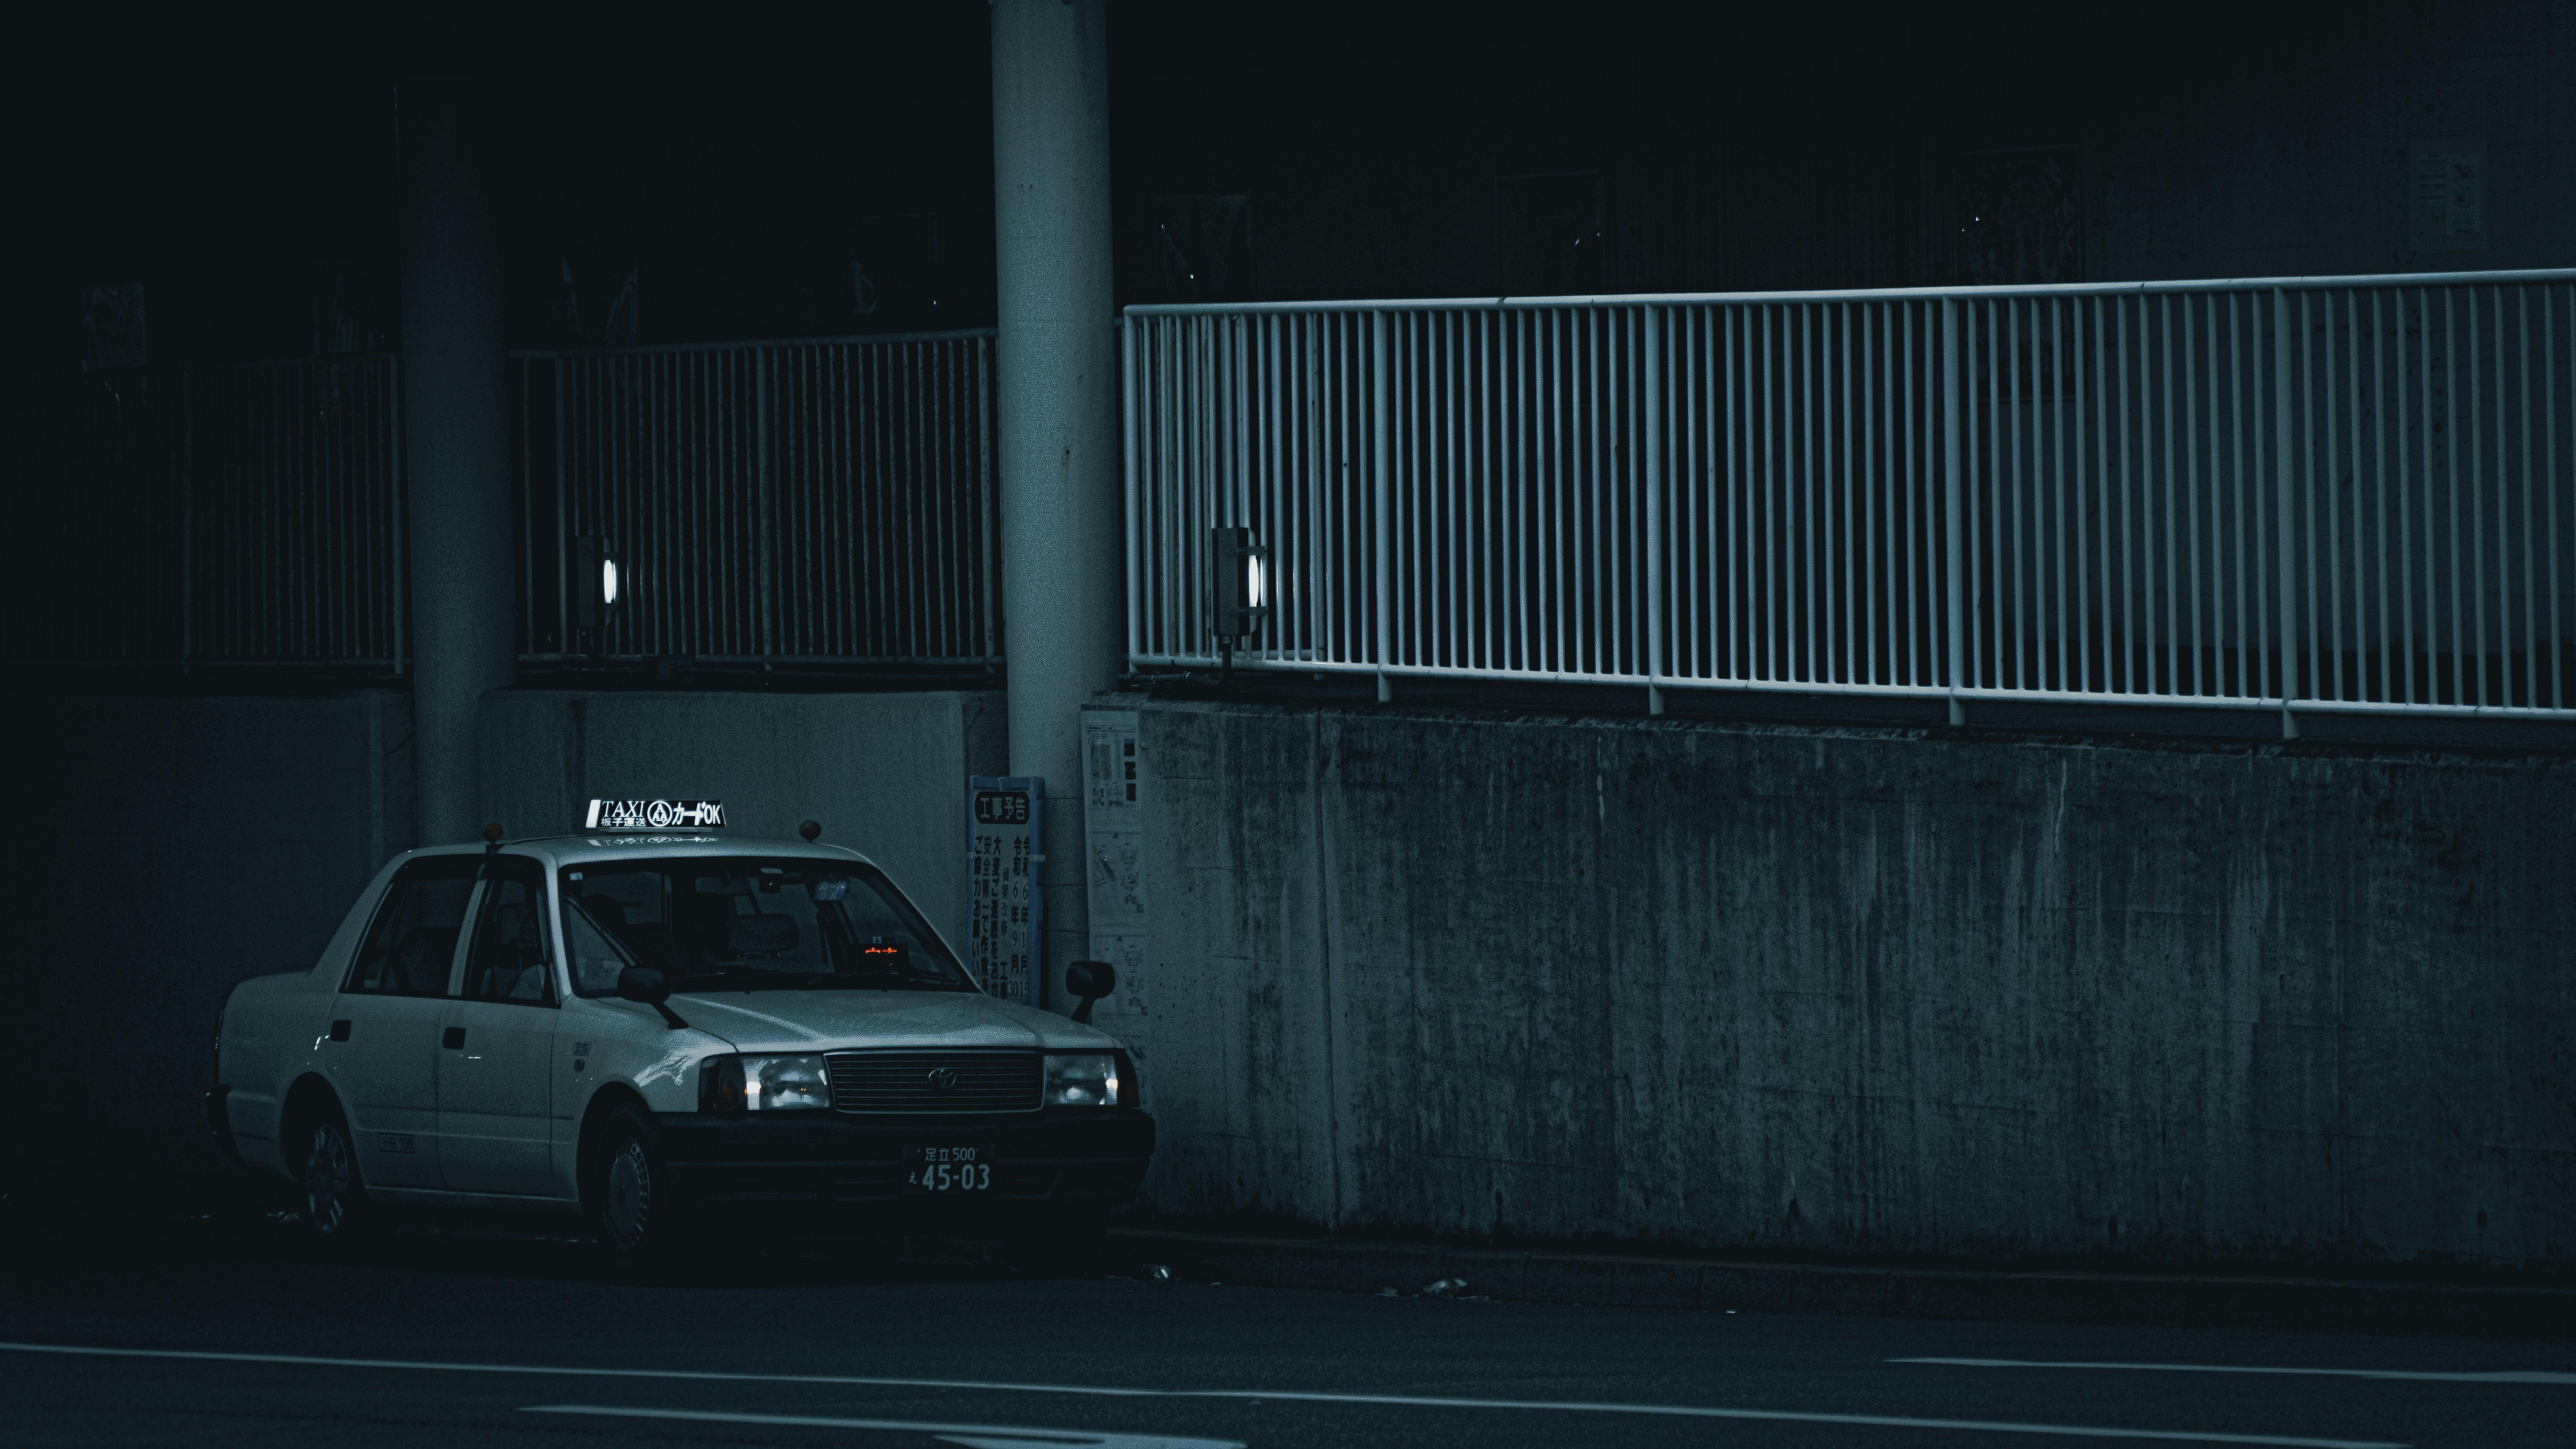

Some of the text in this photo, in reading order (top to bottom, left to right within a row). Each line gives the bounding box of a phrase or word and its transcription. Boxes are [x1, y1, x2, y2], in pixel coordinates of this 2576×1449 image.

[602, 801, 646, 817] TAXI
[980, 796, 1025, 820] 工事予告
[601, 818, 646, 827] 板子運送
[925, 1147, 975, 1161] 足立 500
[908, 1164, 990, 1191] え 45-03
